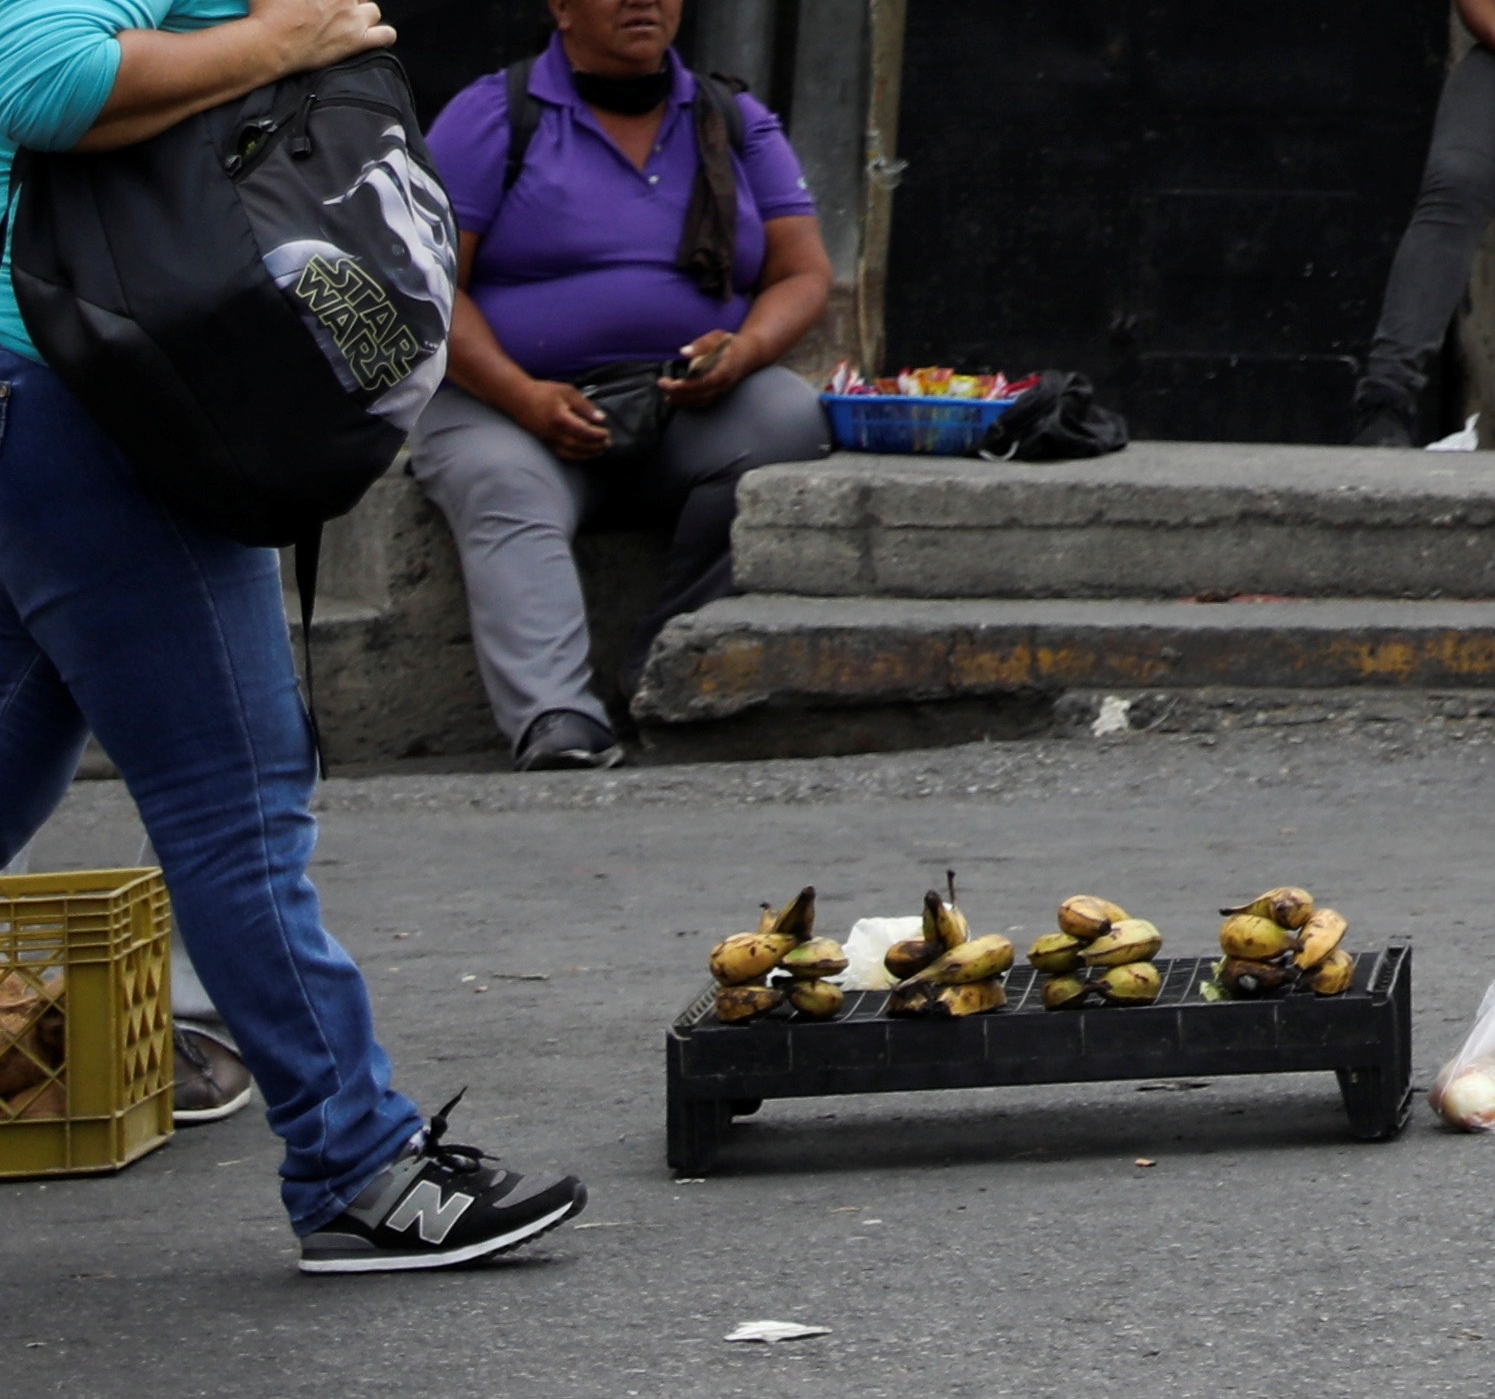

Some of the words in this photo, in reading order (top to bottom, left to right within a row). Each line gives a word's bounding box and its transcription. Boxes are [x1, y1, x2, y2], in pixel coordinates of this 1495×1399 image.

[295, 263, 400, 391] WARS
[310, 253, 419, 379] STAR
[385, 1179, 475, 1245] N
